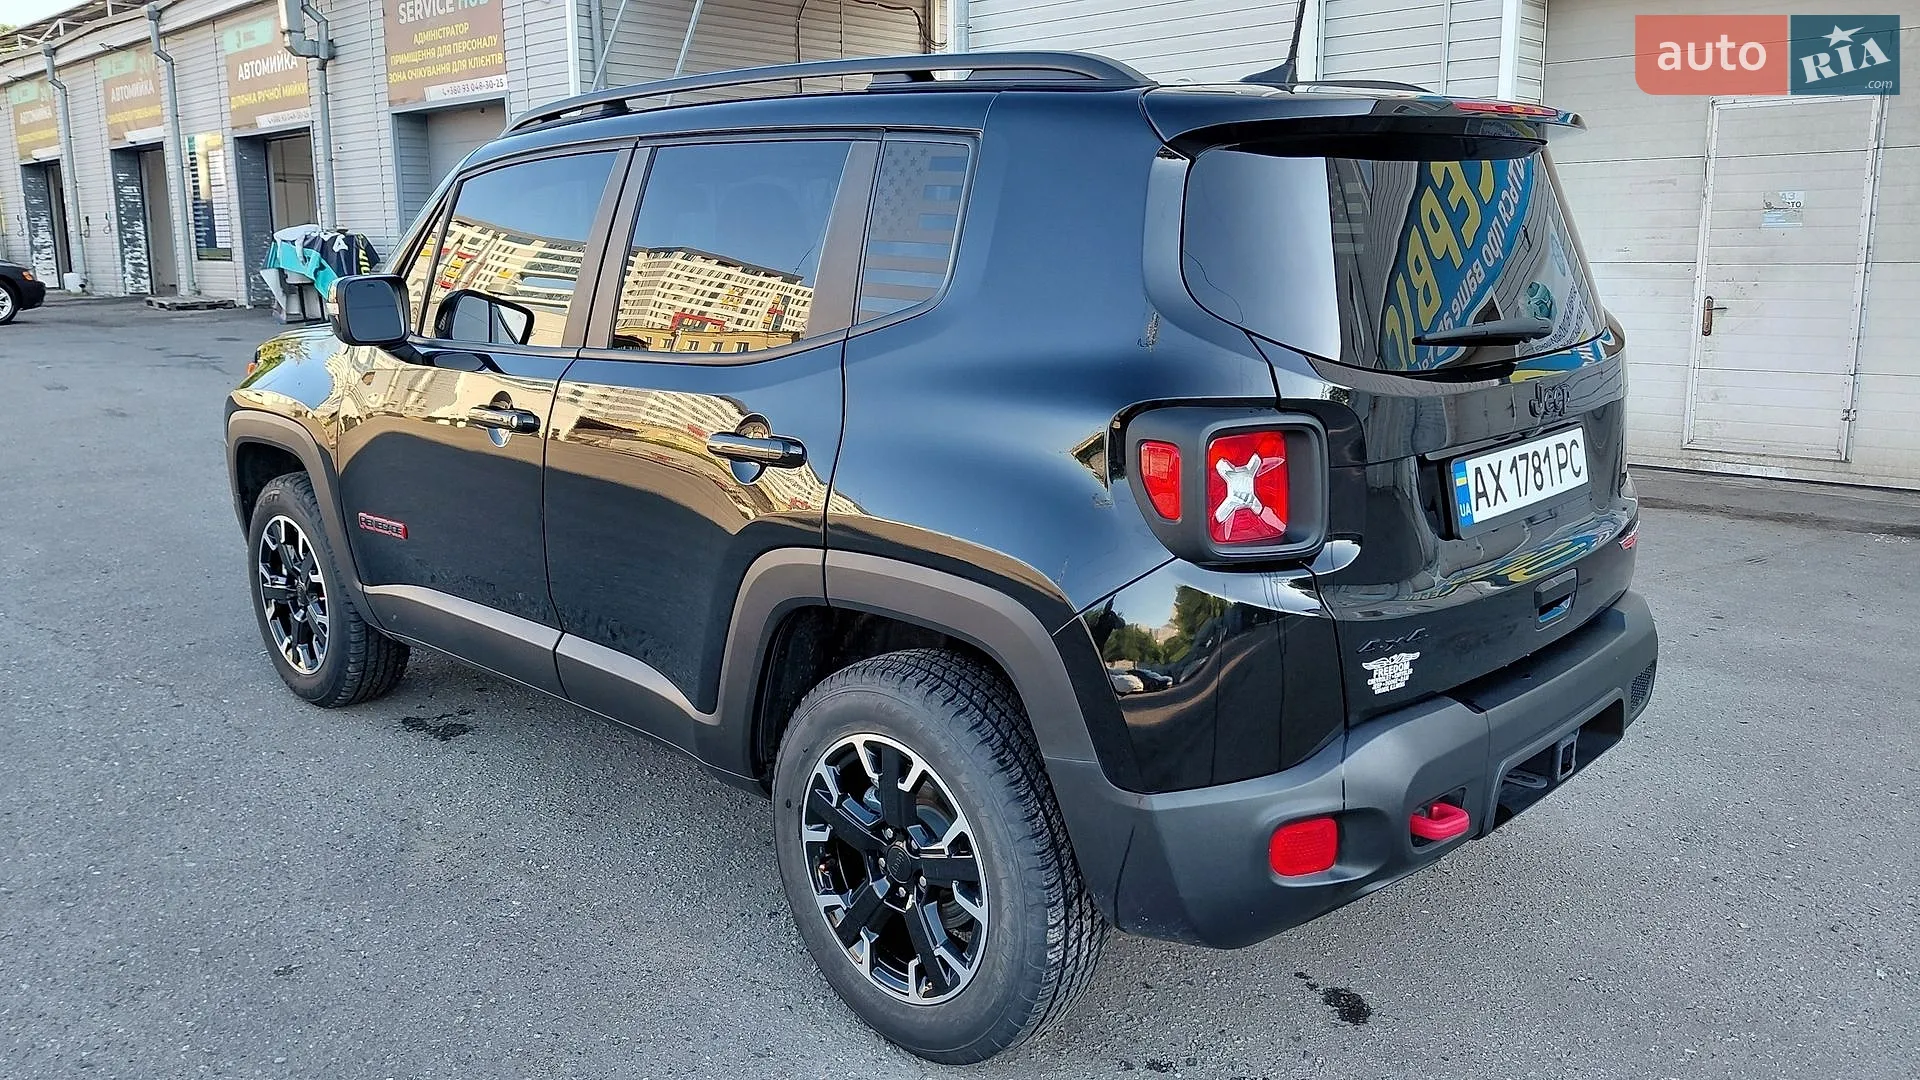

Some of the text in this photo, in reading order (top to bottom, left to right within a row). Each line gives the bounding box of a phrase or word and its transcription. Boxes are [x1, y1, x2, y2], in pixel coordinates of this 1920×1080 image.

[398, 0, 455, 25] SERVICE
[390, 34, 499, 66] ПРИМІЩЕННЯ ДЛЯ ПЕРСОНАЛУ
[413, 22, 470, 46] АДМІНІСТРАТОР
[238, 49, 298, 81] АВТОМИЙКА
[388, 52, 504, 84] ЗОНА ОЧІКУВАННЯ ДЛЯ КЛІЄНТІВ
[1528, 382, 1571, 417] Jeep
[1474, 439, 1582, 512] AX 1781 PC
[1459, 503, 1472, 517] UA
[1373, 661, 1410, 680] FREEDOM
